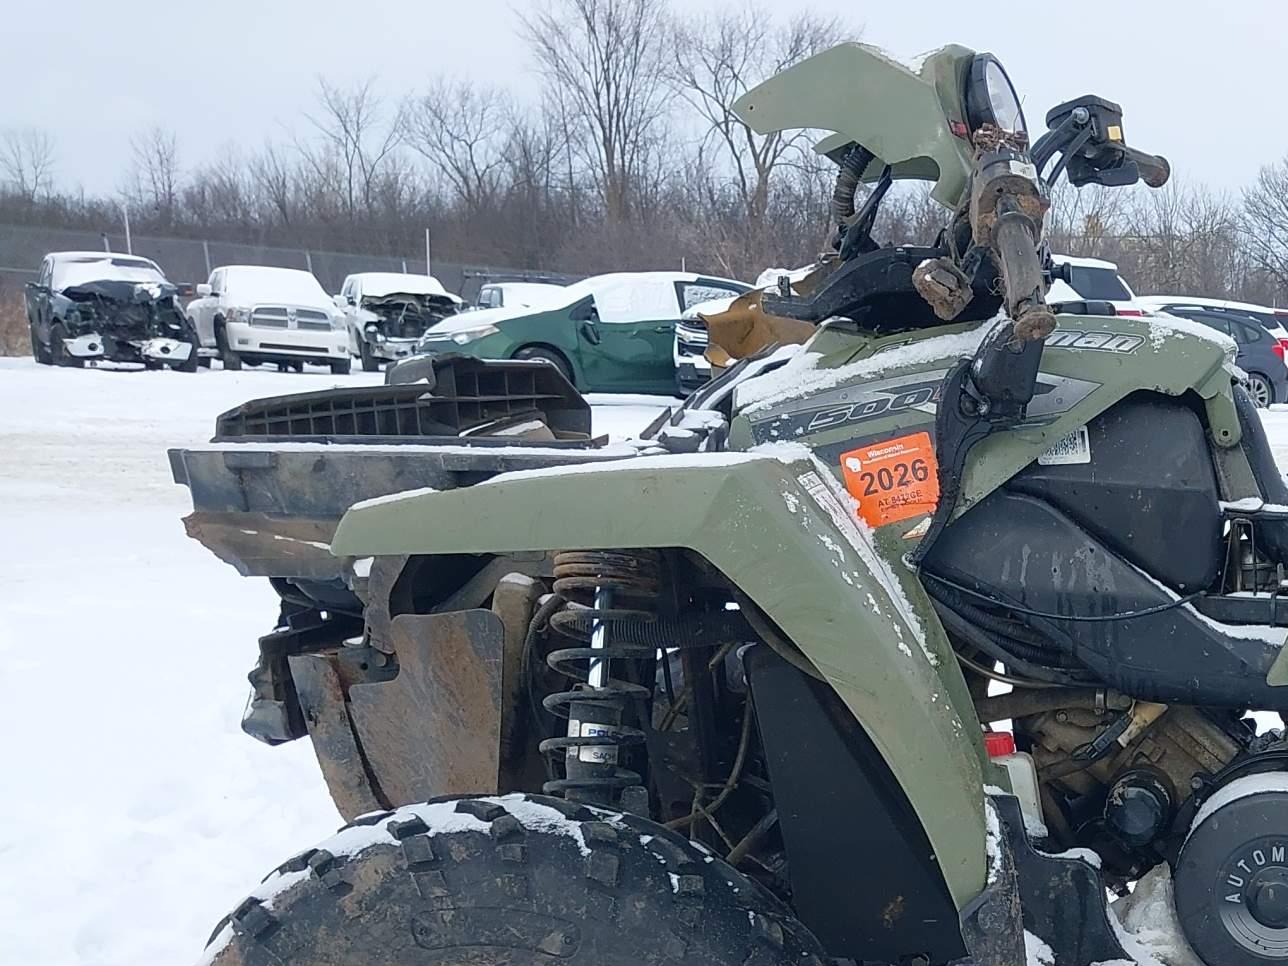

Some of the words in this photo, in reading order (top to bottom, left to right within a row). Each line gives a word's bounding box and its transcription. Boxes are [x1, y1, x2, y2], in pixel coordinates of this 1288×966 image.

[808, 388, 934, 430] 500
[867, 444, 905, 458] Wisconsin
[860, 458, 929, 497] 2026
